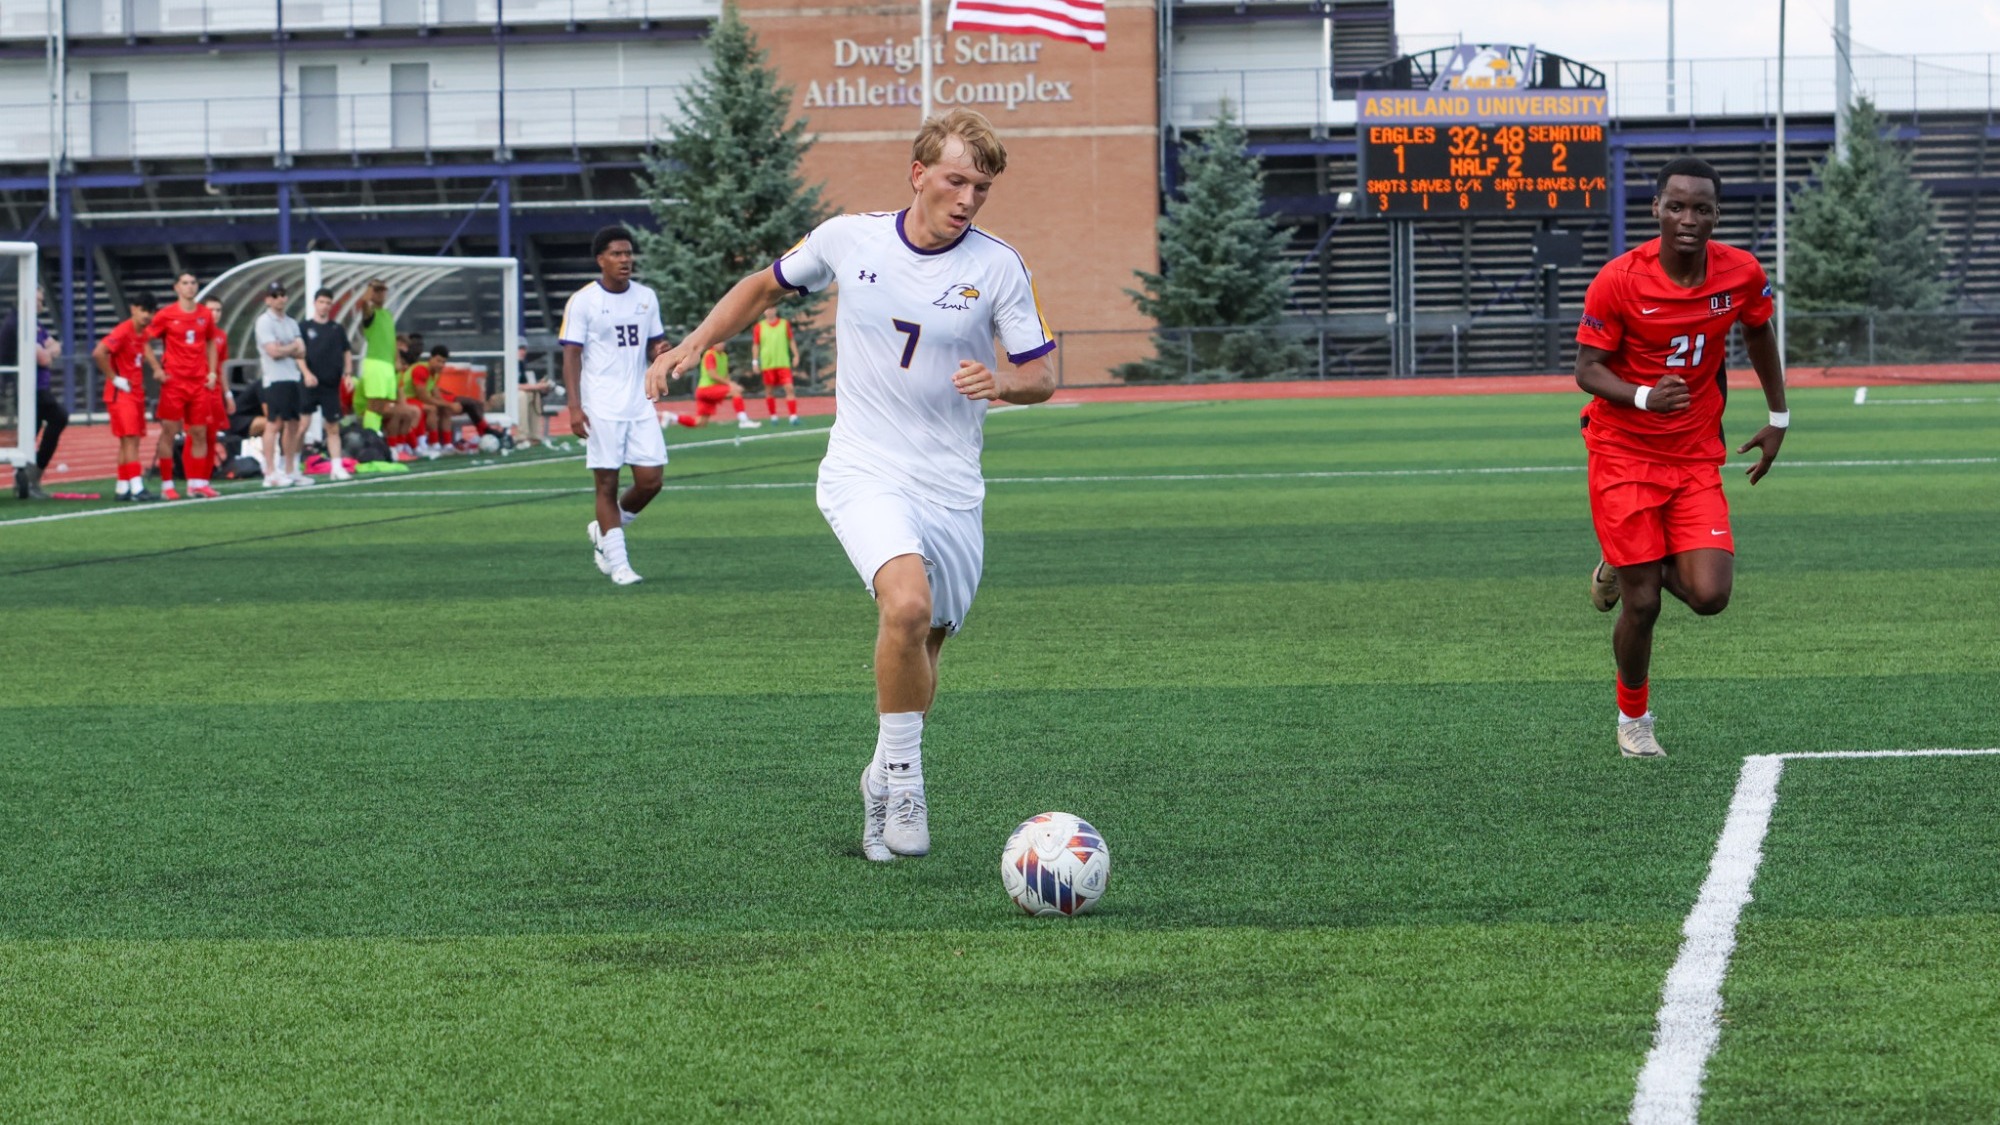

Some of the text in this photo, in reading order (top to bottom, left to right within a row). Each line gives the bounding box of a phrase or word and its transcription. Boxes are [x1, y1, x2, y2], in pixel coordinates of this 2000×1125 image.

[954, 33, 1042, 64] Schar
[803, 73, 1073, 110] Athletic Complex
[1364, 96, 1606, 117] ASHLAND UNIVERSITY
[1370, 126, 1436, 144] EAGLES
[1528, 125, 1602, 142] SENATOR
[1393, 144, 1405, 174] 1
[1450, 155, 1522, 177] HALF 2
[1552, 142, 1567, 172] 2
[1367, 180, 1407, 193] SHOTS
[1411, 179, 1451, 193] SAVES
[1494, 178, 1534, 191] SHOTS
[1536, 177, 1576, 191] SAVES
[1379, 193, 1388, 211] 3
[1423, 193, 1428, 210] 1
[1506, 191, 1590, 209] 5 0 1
[615, 324, 639, 347] 38
[891, 317, 921, 370] 7
[1666, 333, 1705, 367] 21
